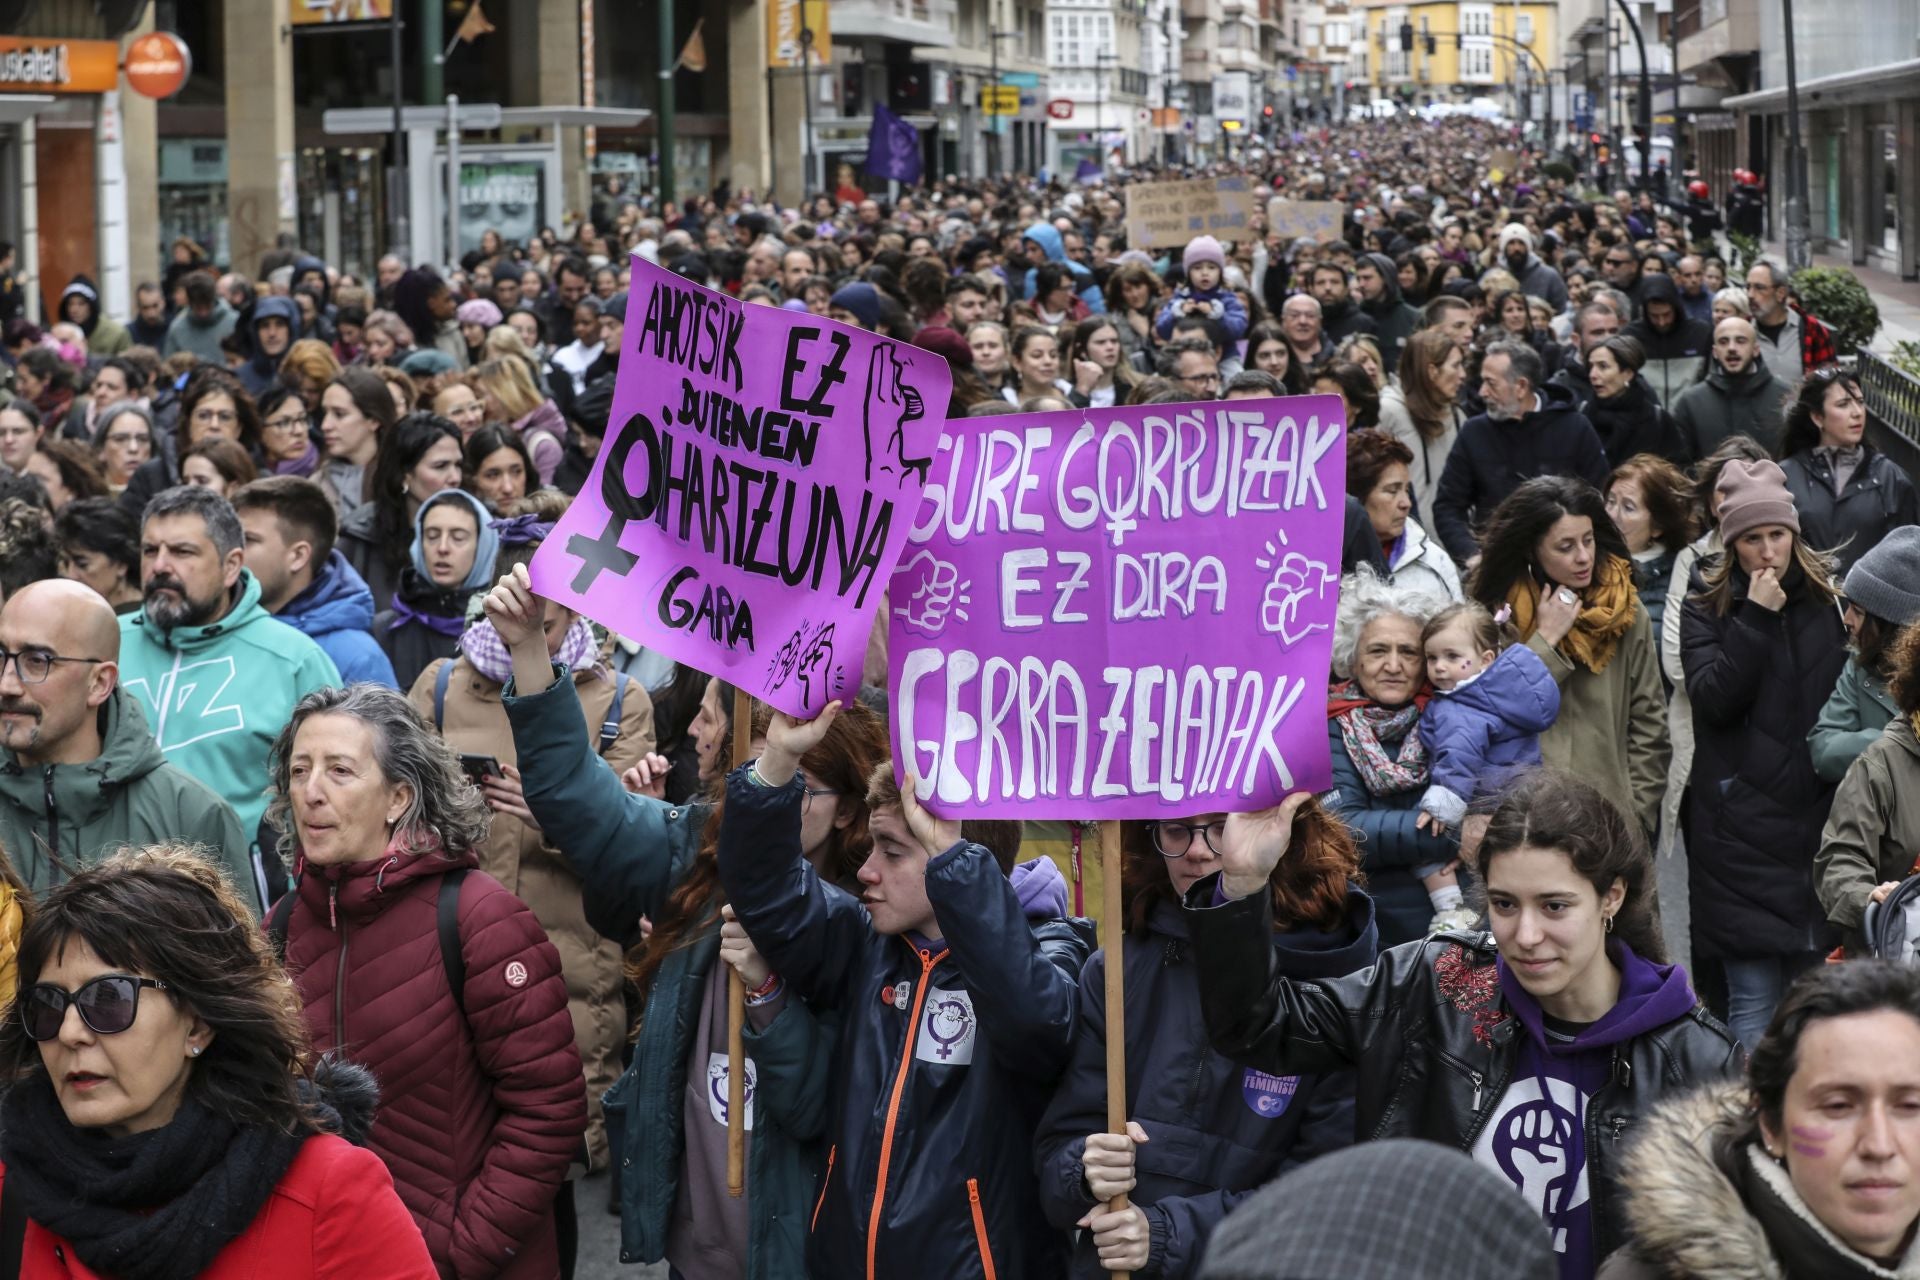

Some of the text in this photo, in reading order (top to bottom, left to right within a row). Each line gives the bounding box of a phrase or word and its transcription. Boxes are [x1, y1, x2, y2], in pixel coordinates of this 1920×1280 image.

[780, 326, 851, 418] EZ
[677, 377, 821, 468] DUTENEN
[657, 566, 755, 652] GARA
[1001, 547, 1228, 628] EZ DIRA
